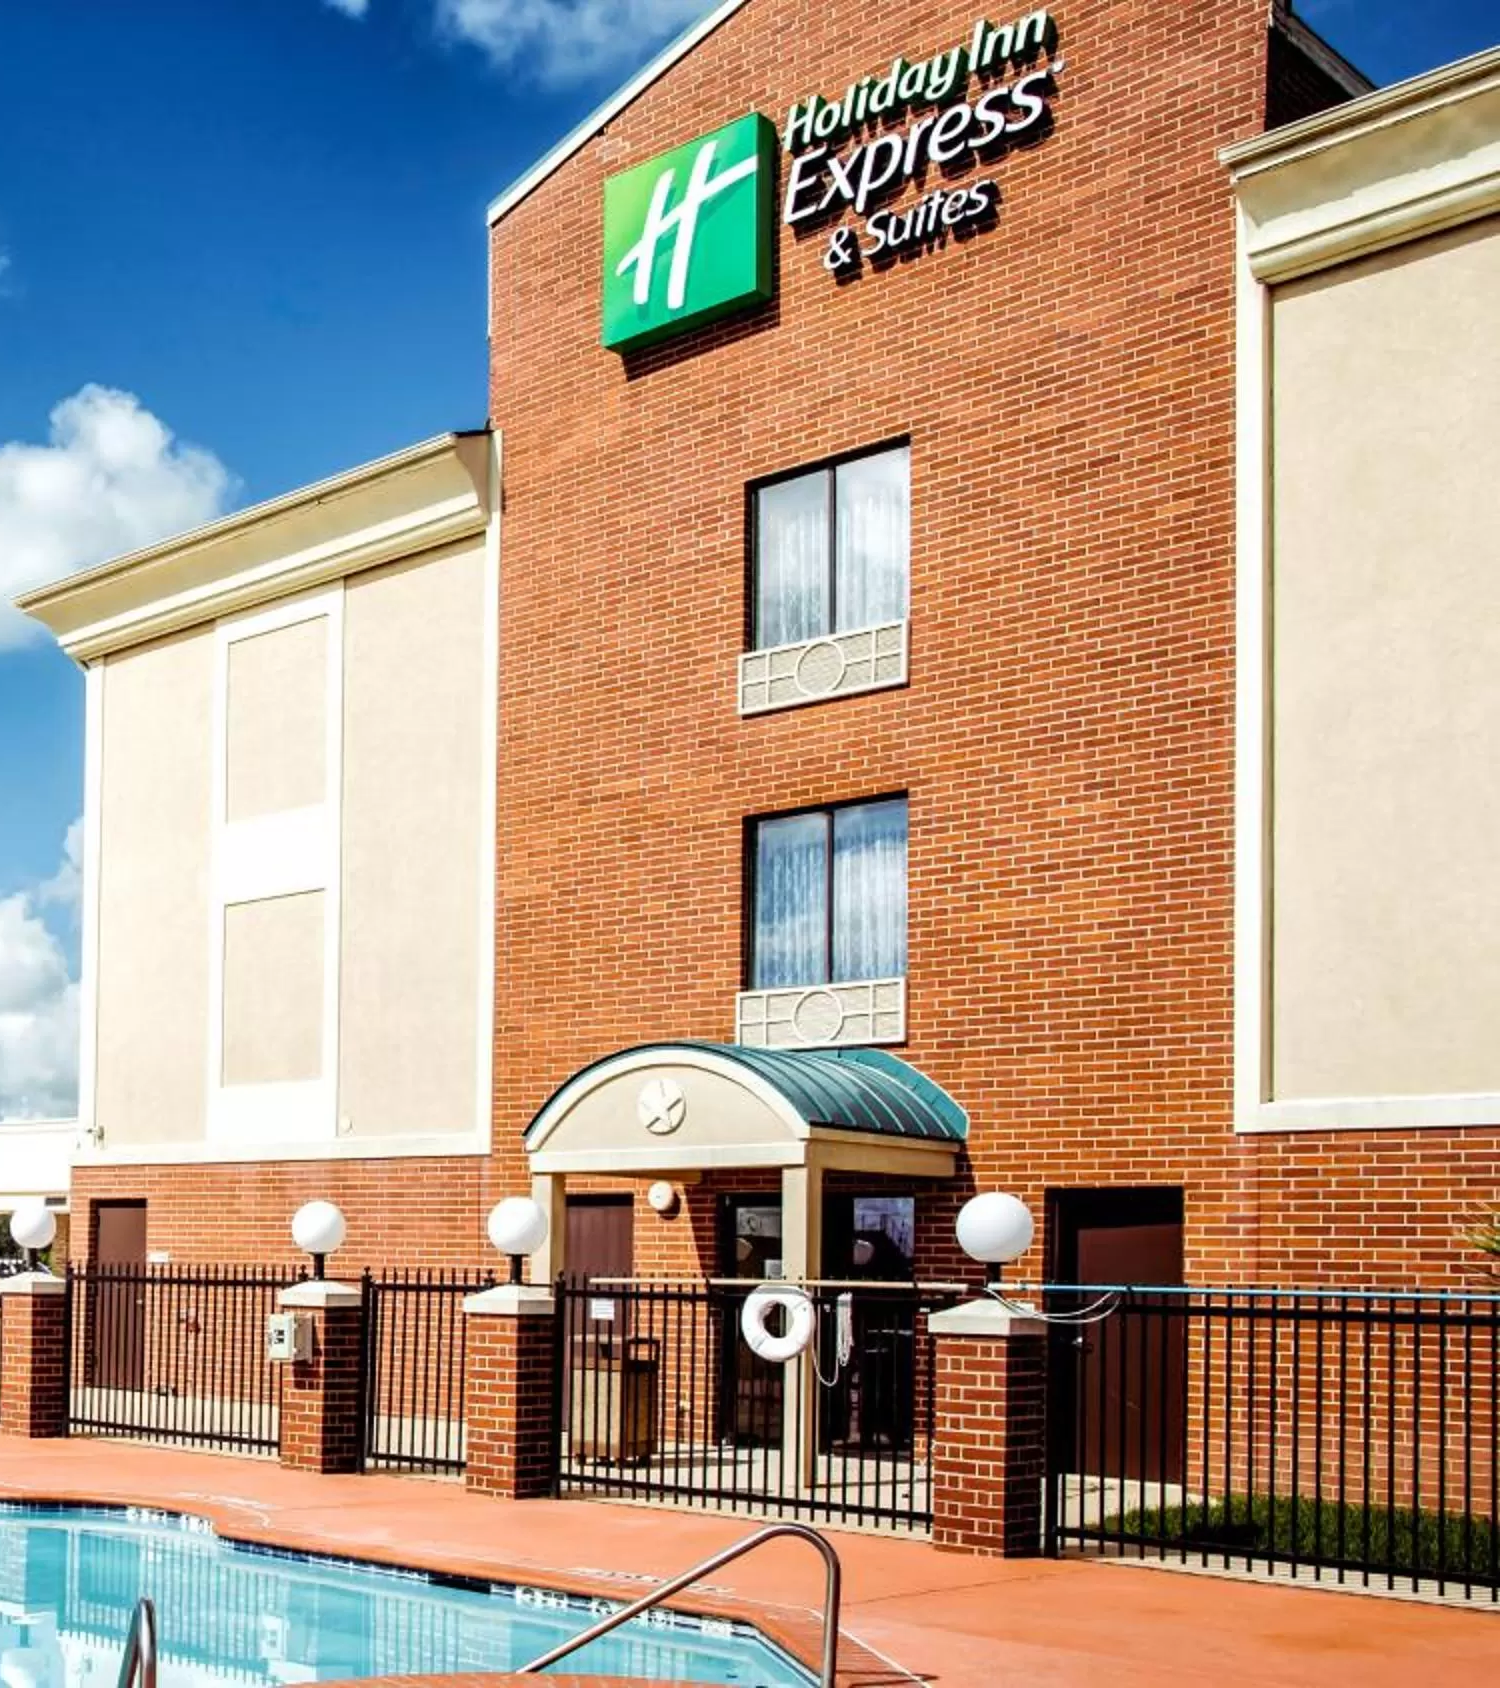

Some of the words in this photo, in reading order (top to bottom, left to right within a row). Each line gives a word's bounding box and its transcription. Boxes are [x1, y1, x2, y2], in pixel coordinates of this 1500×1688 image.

[781, 46, 962, 151] Holiday
[969, 9, 1047, 73] Inn
[783, 70, 1049, 224] Express
[823, 229, 852, 271] &
[862, 180, 994, 258] Suites
